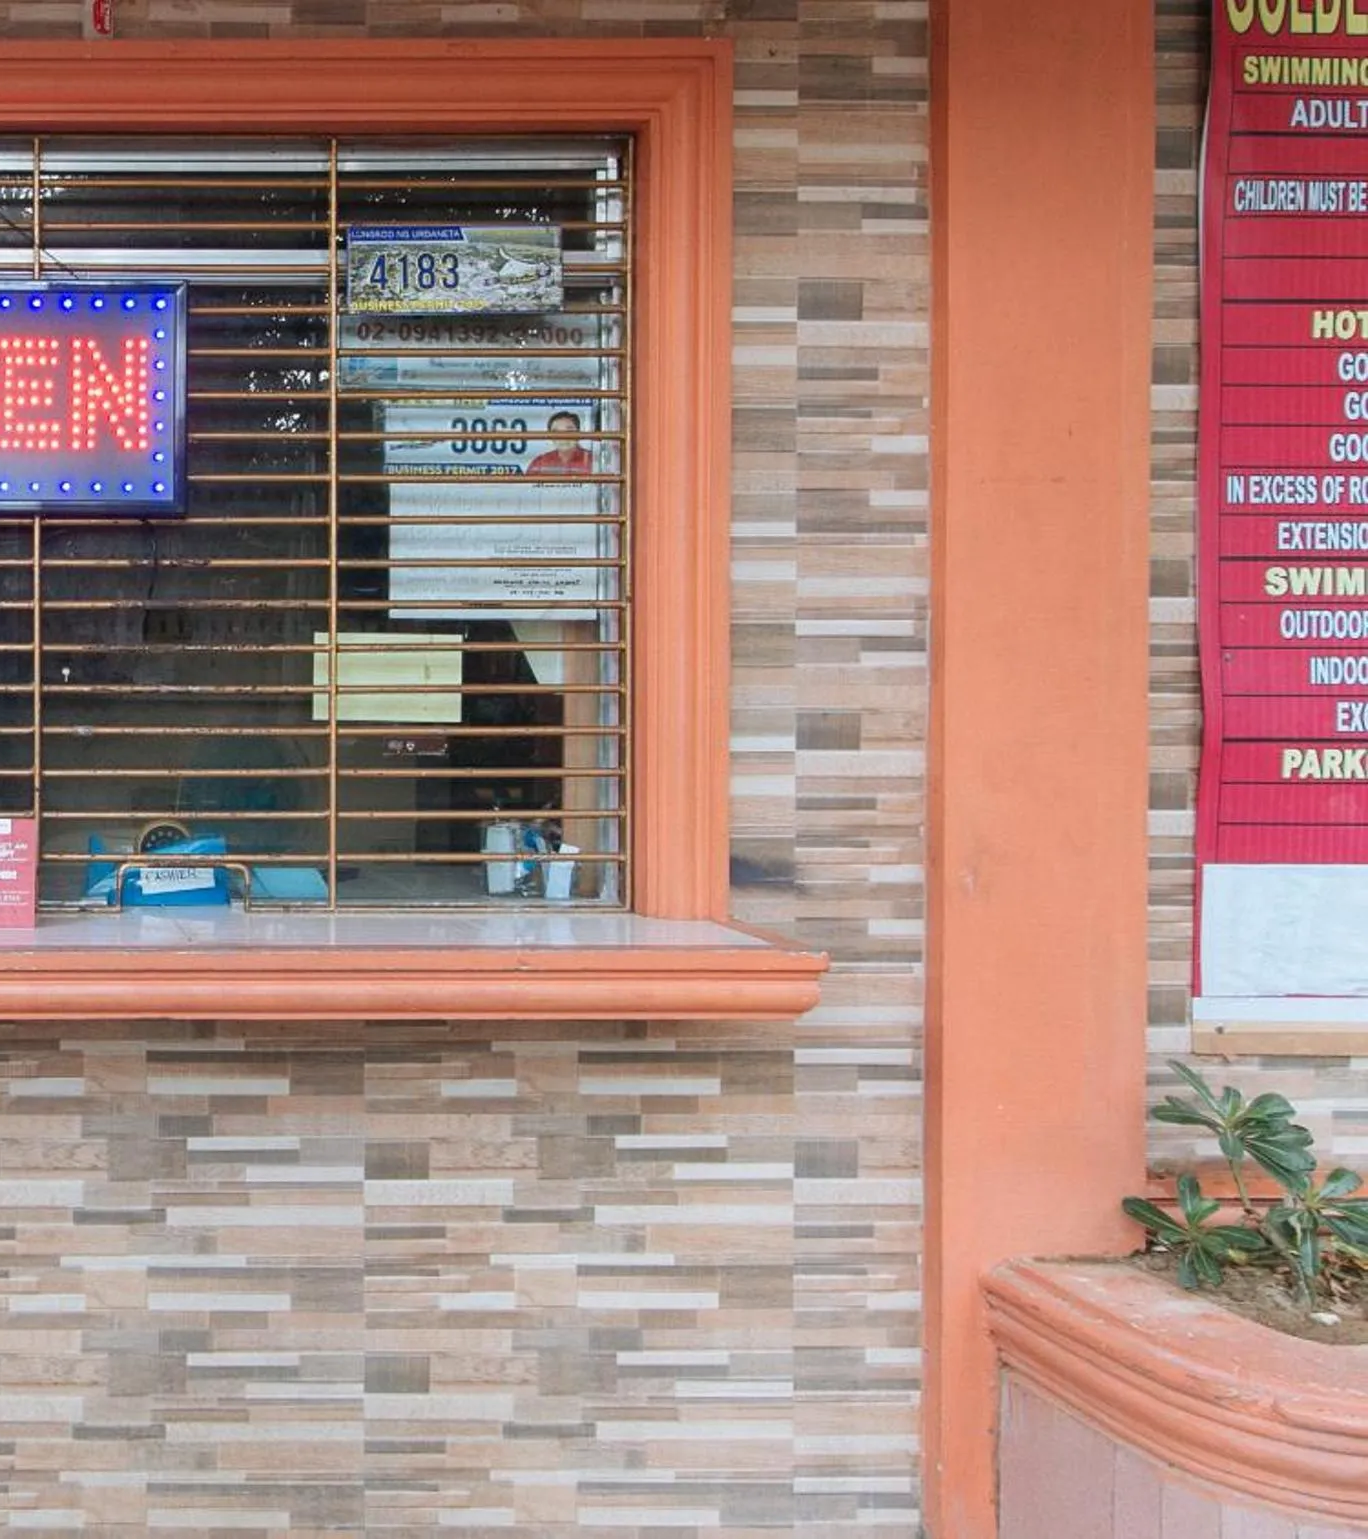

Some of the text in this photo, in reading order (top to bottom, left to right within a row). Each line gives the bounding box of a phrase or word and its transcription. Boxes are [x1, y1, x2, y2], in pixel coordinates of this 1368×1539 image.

[1234, 180, 1305, 211] CHILDREN
[1307, 181, 1346, 211] MUST
[370, 253, 459, 290] 4183
[1227, 475, 1245, 504] IN
[1249, 475, 1317, 504] EXCESS
[1322, 476, 1345, 504] OF
[1336, 701, 1368, 732] EX
[1282, 748, 1368, 779] PARK
